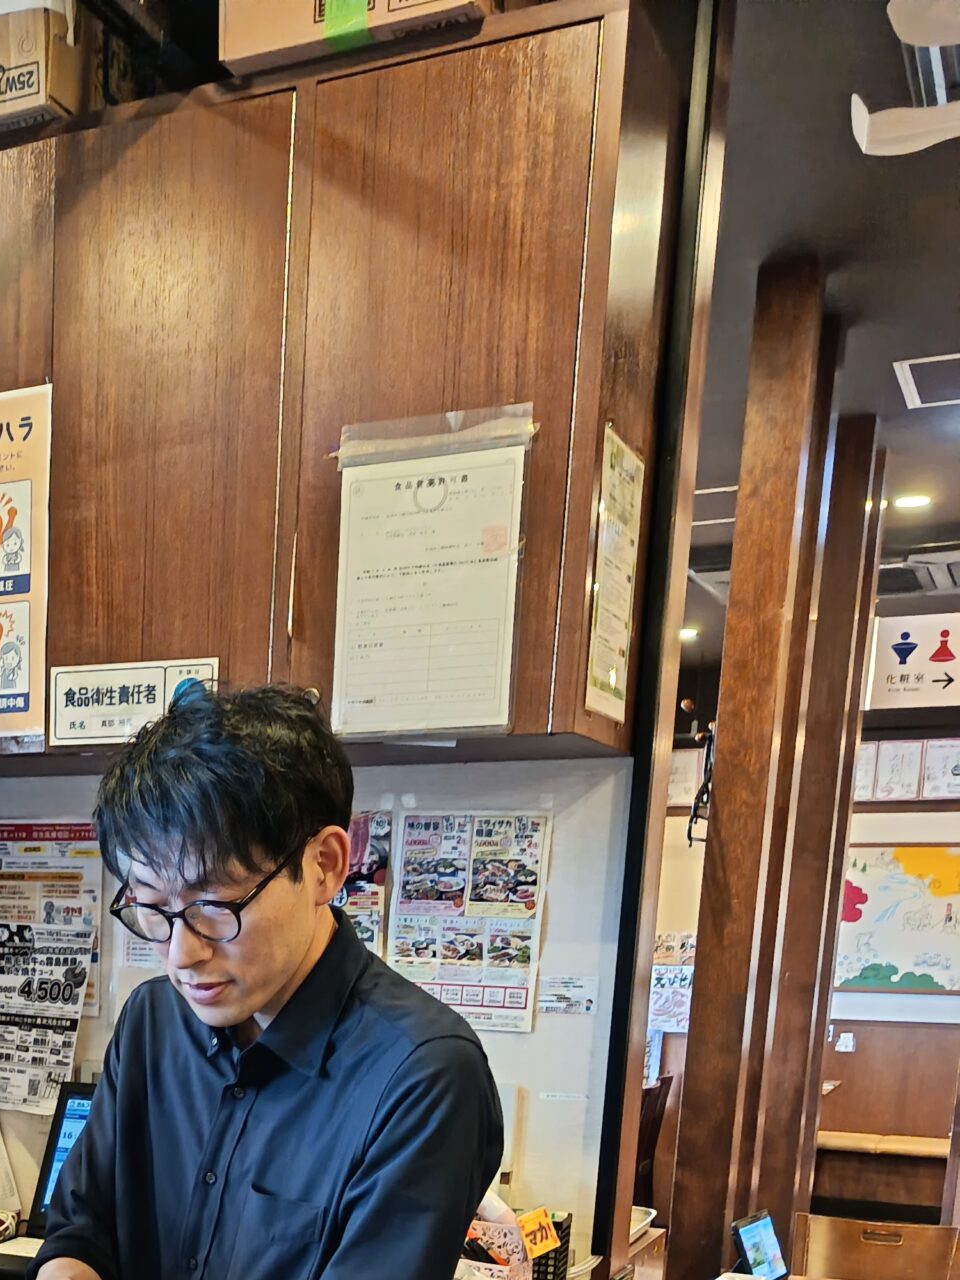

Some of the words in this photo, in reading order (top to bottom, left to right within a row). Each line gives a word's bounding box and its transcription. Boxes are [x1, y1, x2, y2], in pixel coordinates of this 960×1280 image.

[63, 683, 157, 708] 食品衛生責任者
[69, 720, 86, 730] 氏名
